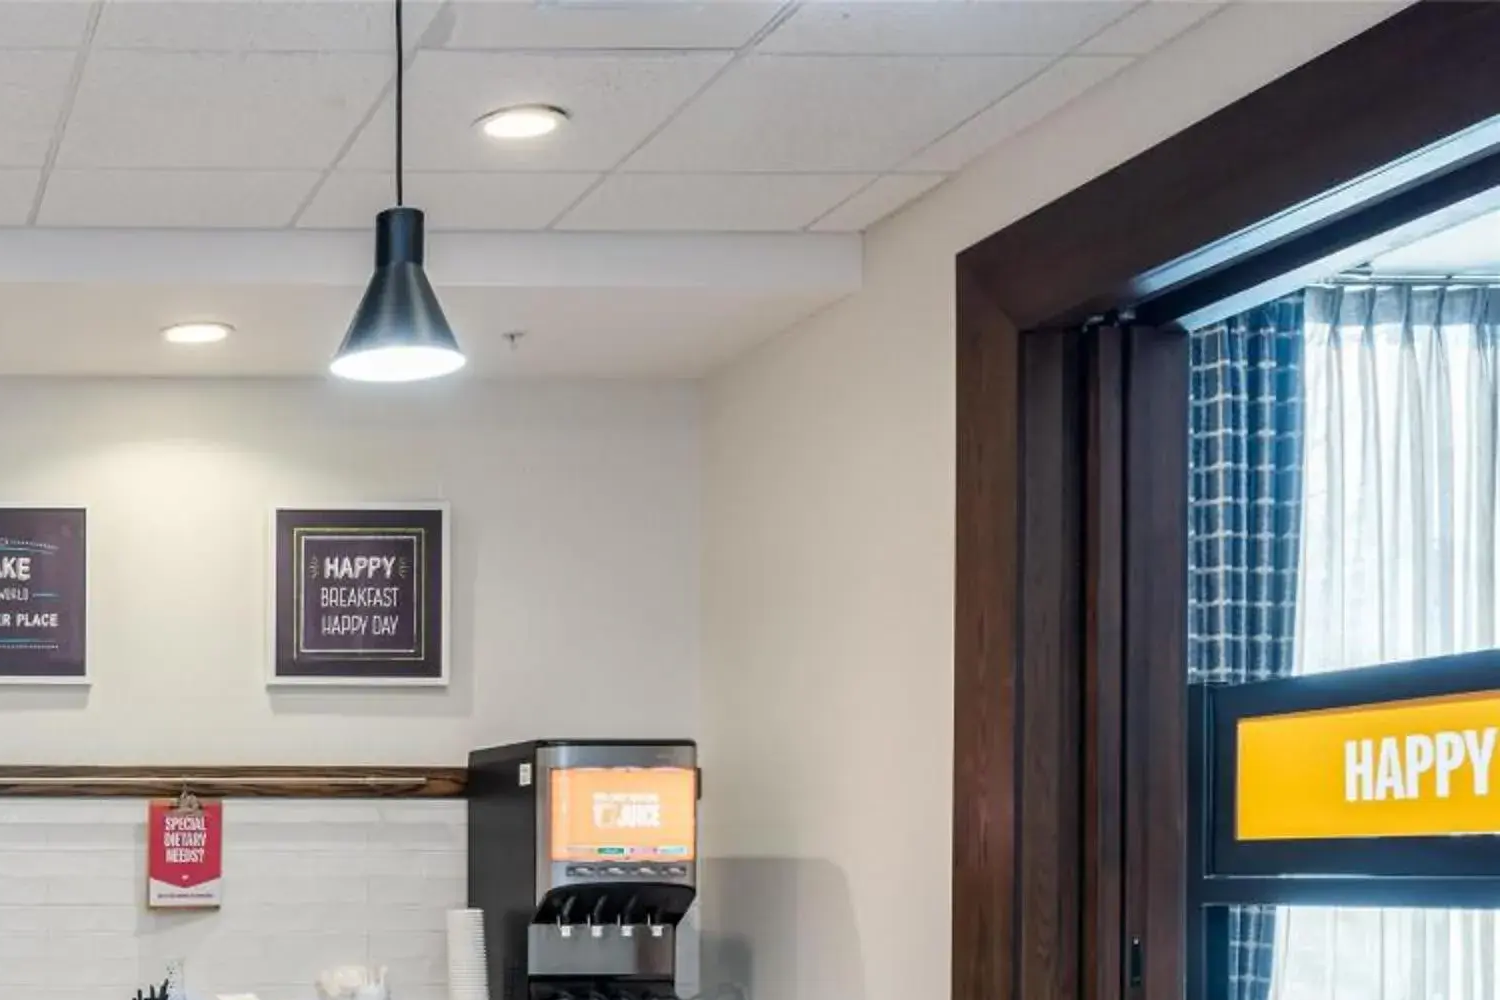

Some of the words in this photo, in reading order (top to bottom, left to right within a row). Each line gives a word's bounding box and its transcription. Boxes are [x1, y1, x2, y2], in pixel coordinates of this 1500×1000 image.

[324, 556, 396, 579] HAPPY
[320, 587, 399, 608] BREAKFAST
[16, 613, 59, 628] PLACE
[321, 615, 369, 636] HAPPY
[372, 615, 399, 636] DAY
[1344, 727, 1498, 802] HAPPY
[165, 816, 207, 831] SPECIAL
[164, 831, 207, 847] DIETARY
[165, 847, 205, 863] NEEDS?
